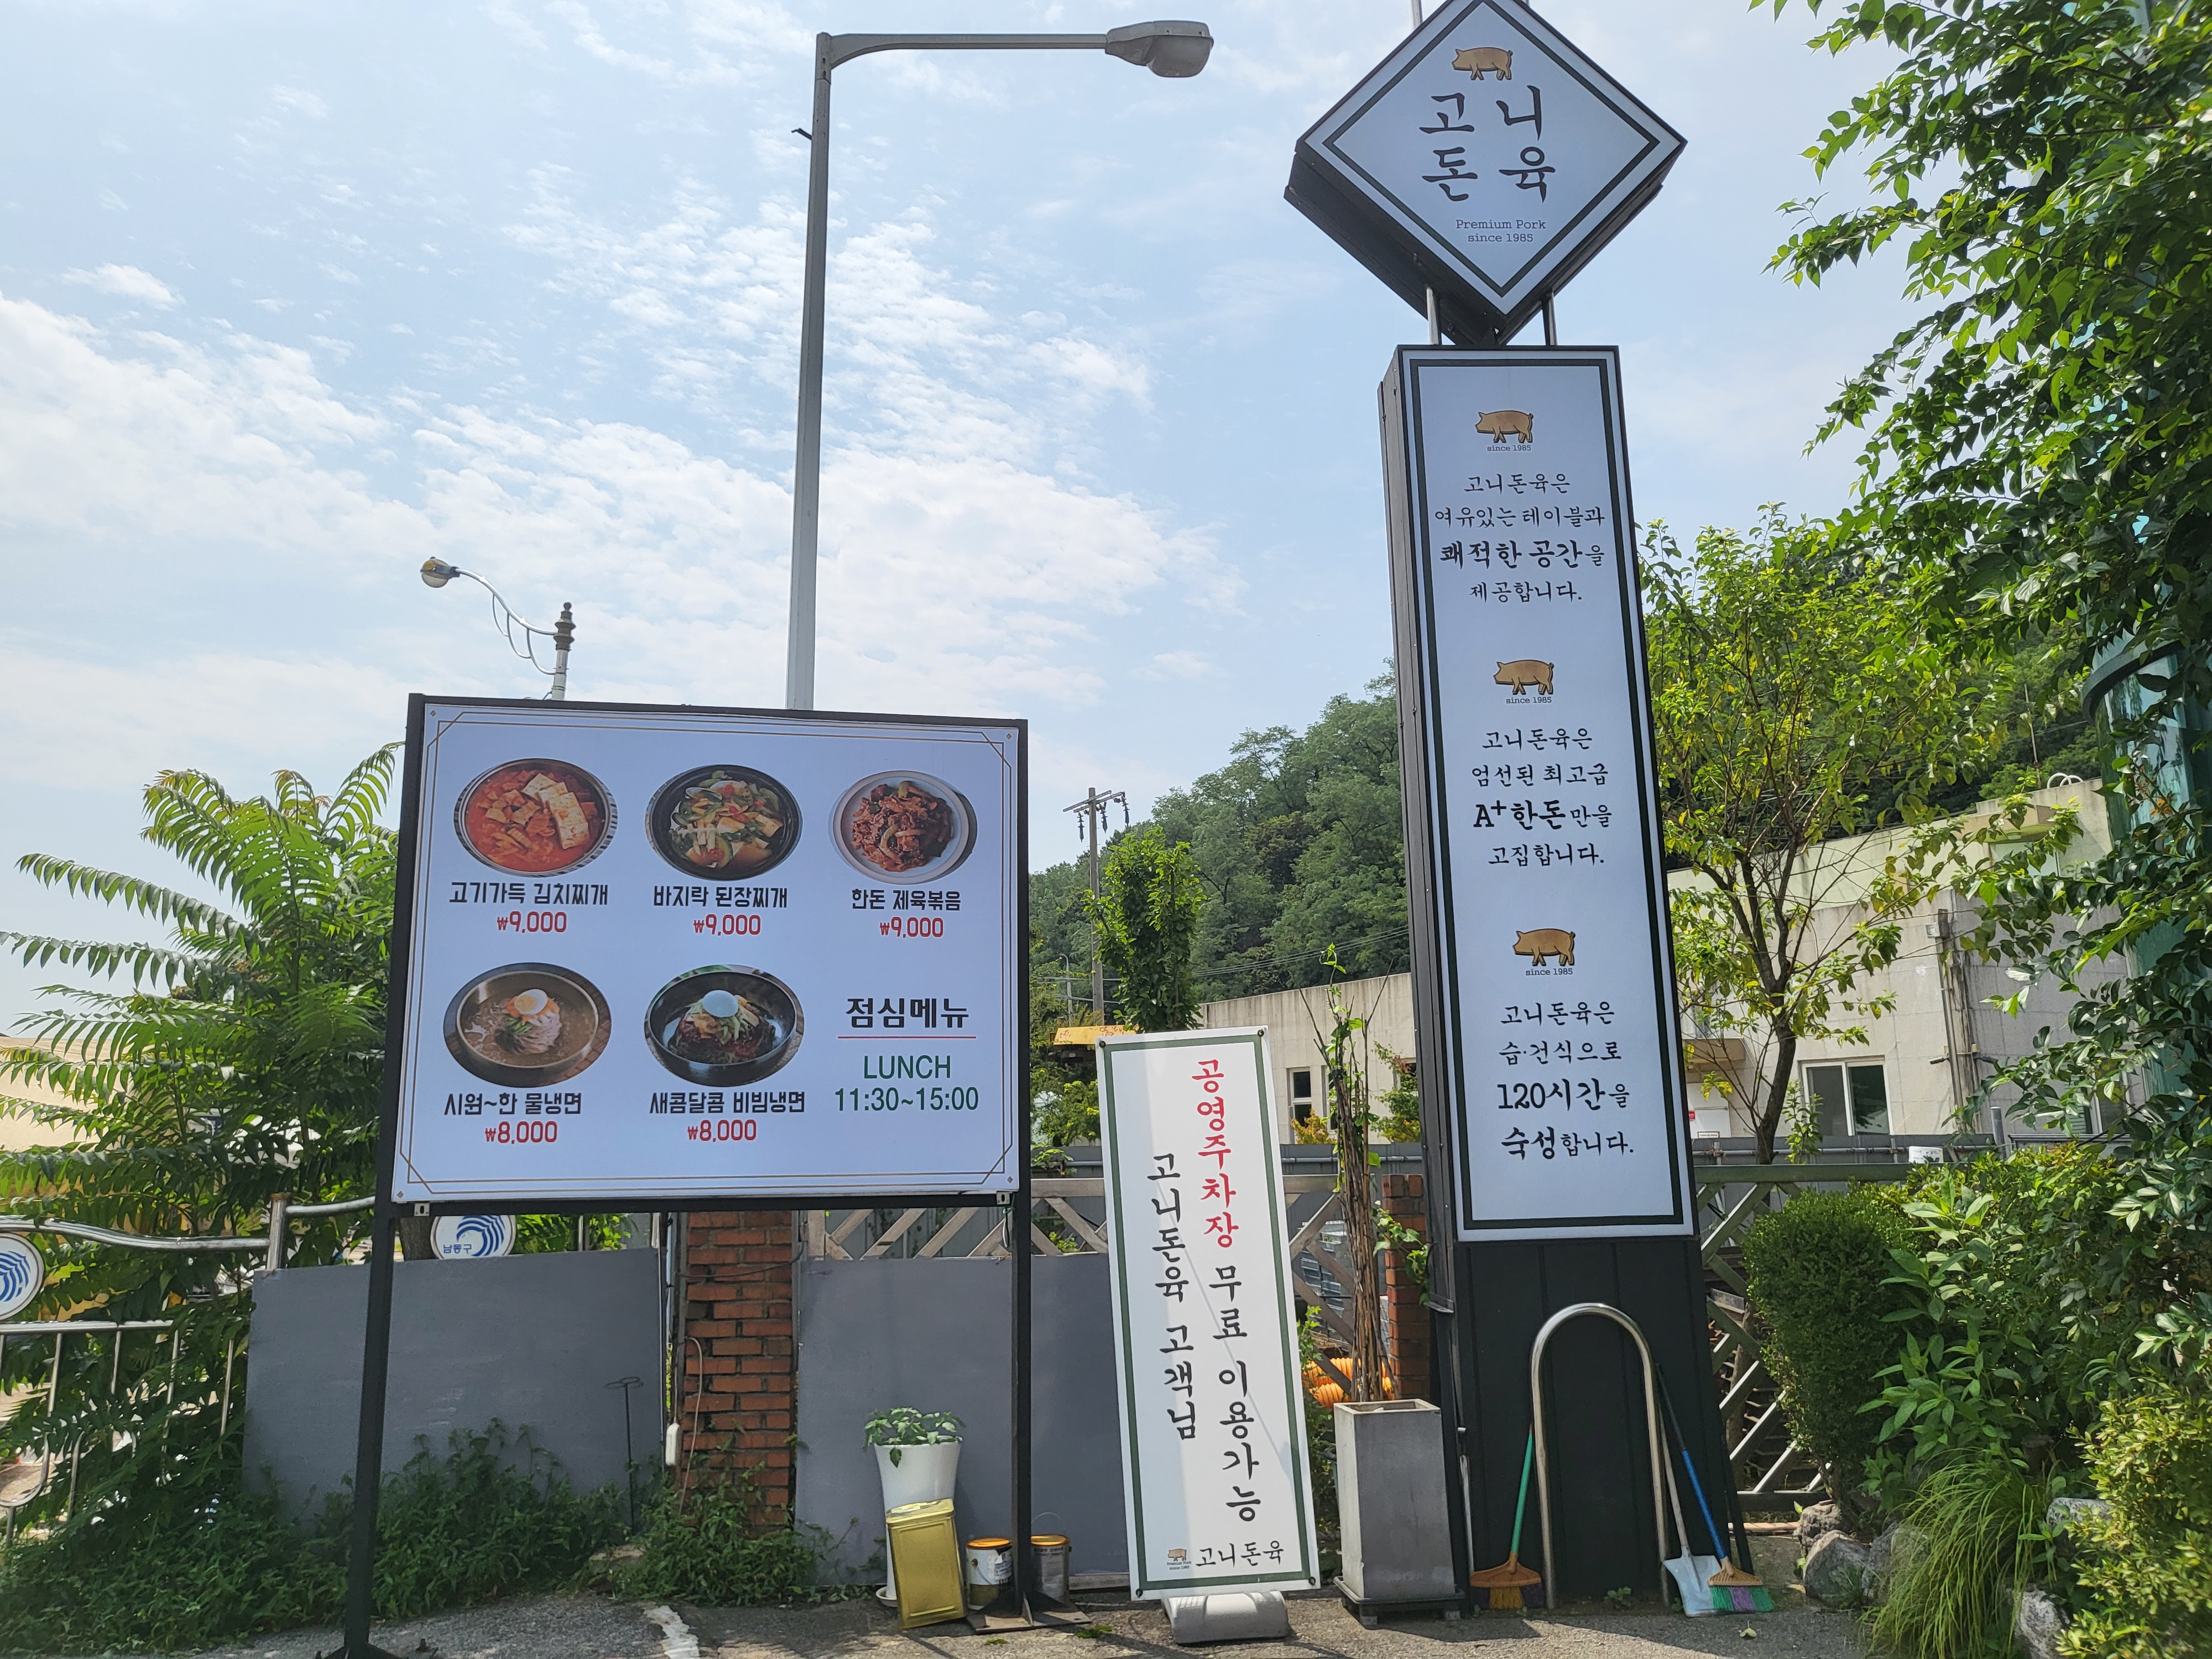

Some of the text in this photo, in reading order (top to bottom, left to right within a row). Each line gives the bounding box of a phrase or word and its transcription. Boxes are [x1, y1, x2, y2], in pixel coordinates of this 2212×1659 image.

[1455, 219, 1547, 229] Premium Pork
[1468, 233, 1533, 242] since 1985
[1464, 473, 1571, 494] 고니돈육은
[1434, 506, 1605, 529] 여유있는 테이블과
[1439, 539, 1605, 570] 쾌적한 공간을
[1469, 581, 1582, 603] 제공합니다.
[1481, 728, 1593, 751] 고니돈육은
[1472, 763, 1609, 787] 엄선된 최고급
[1488, 842, 1604, 867] 고집합니다.
[449, 881, 608, 905] 고기가득 김치찌개
[654, 885, 787, 908] 바지락 된장찌개
[852, 888, 961, 911] 한돈 제육볶음
[845, 998, 969, 1029] 점심메뉴
[1500, 1001, 1615, 1026] 고니돈육은
[864, 1055, 951, 1079] LUNCH
[444, 1092, 582, 1115] 시원~한 물냉면
[649, 1091, 805, 1114] 새콤달콤 비빔냉면
[834, 1087, 979, 1112] 11:30~15:00
[1496, 1077, 1630, 1112] 120시간을
[1501, 1126, 1634, 1161] 숙성합니다.
[443, 1244, 472, 1254] 남동구
[1146, 1153, 1196, 1441] 고니돈육 고객님
[1191, 1059, 1261, 1522] 공영주차장 무료 이용가능
[1195, 1540, 1284, 1567] 고니돈육
